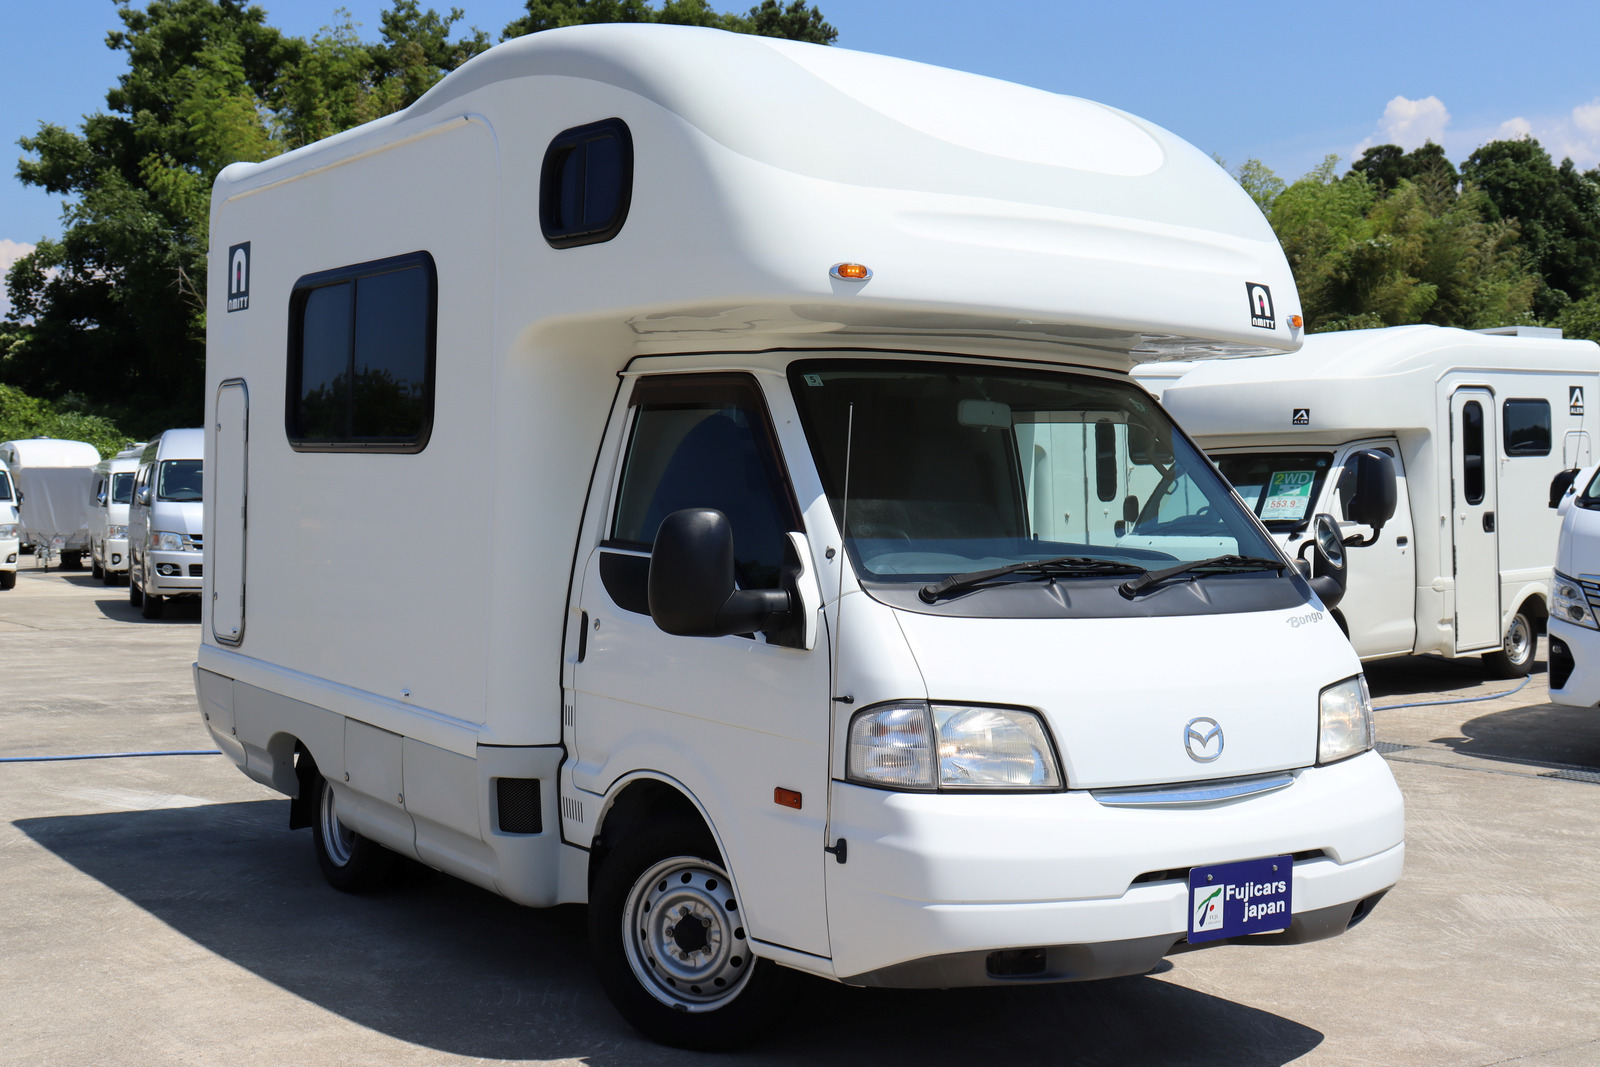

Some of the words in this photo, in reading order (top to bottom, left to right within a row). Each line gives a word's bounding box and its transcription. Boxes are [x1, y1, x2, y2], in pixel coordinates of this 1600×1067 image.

[1252, 317, 1275, 329] AMITY
[1274, 473, 1310, 485] 2WD
[1270, 500, 1296, 509] 553.9
[1286, 612, 1323, 628] Bongo
[1225, 880, 1287, 903] Fujicars
[1242, 900, 1286, 923] japan
